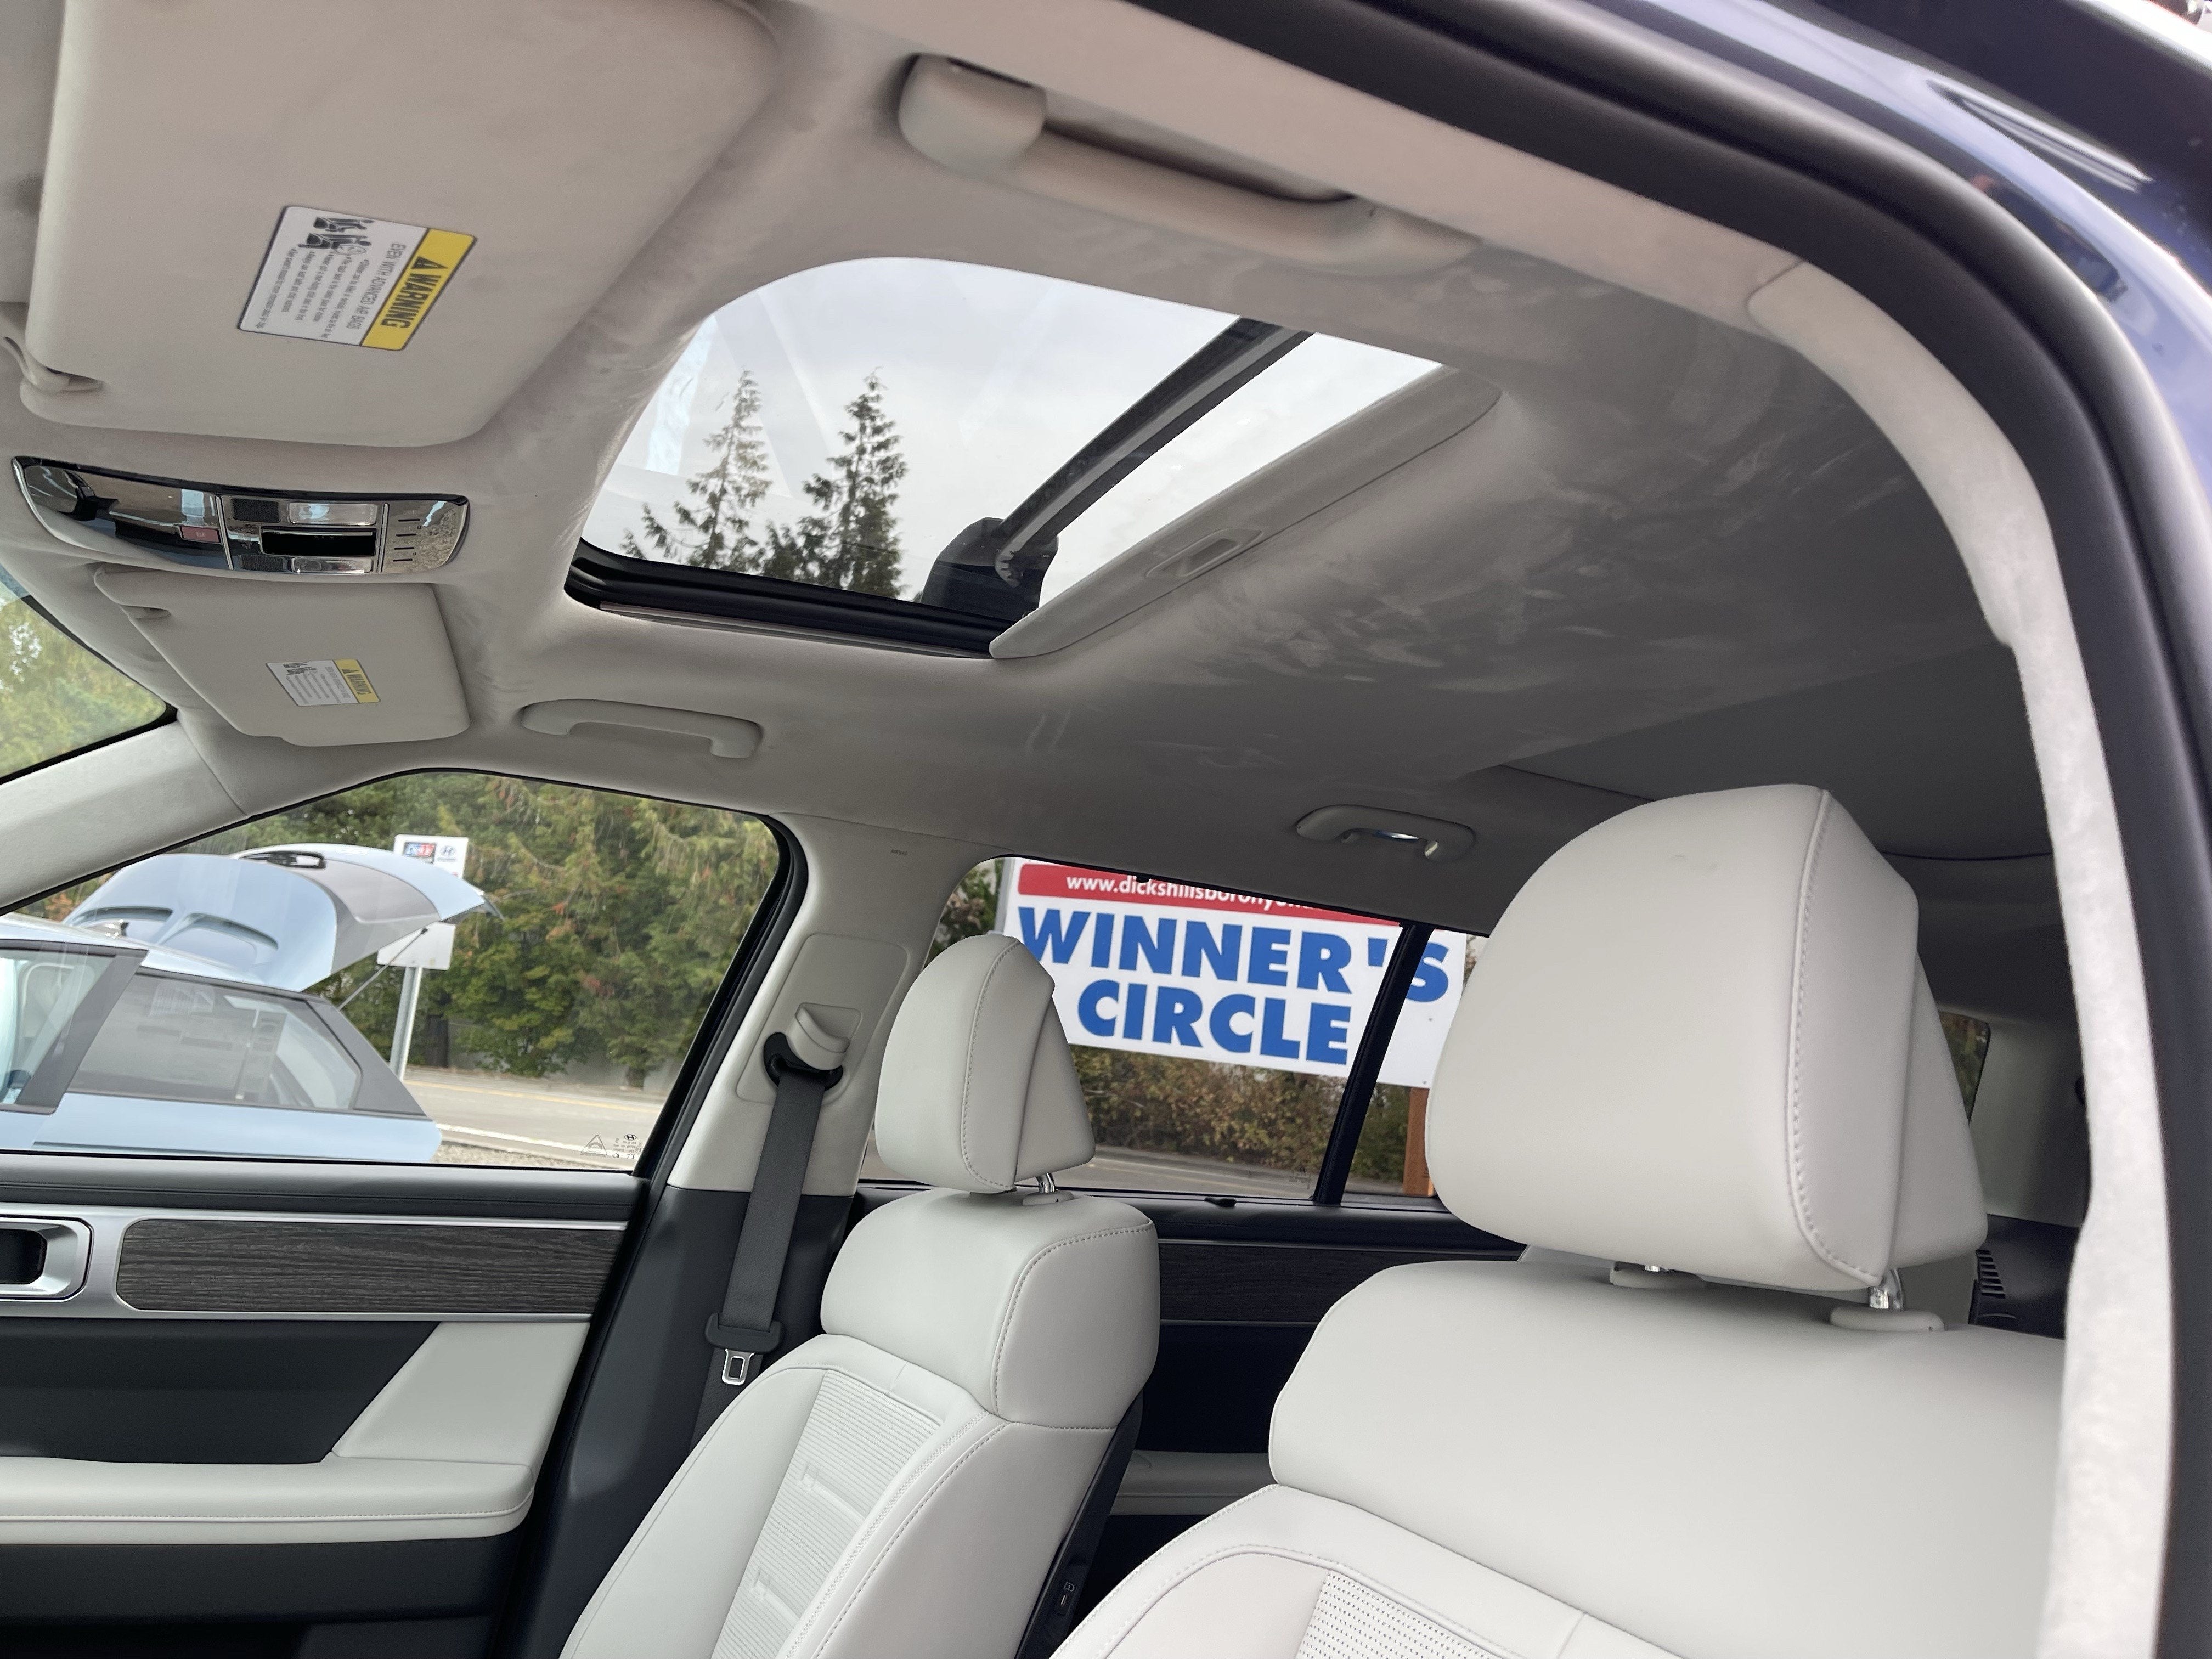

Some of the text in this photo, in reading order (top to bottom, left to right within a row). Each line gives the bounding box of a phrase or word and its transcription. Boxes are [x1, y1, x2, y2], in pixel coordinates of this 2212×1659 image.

[346, 243, 406, 329] EVEN WITH ADVANCED AIR BAGS
[380, 272, 441, 329] WARNING
[1019, 906, 1449, 1002] WINNER'S
[1078, 979, 1351, 1065] CIRCLE
